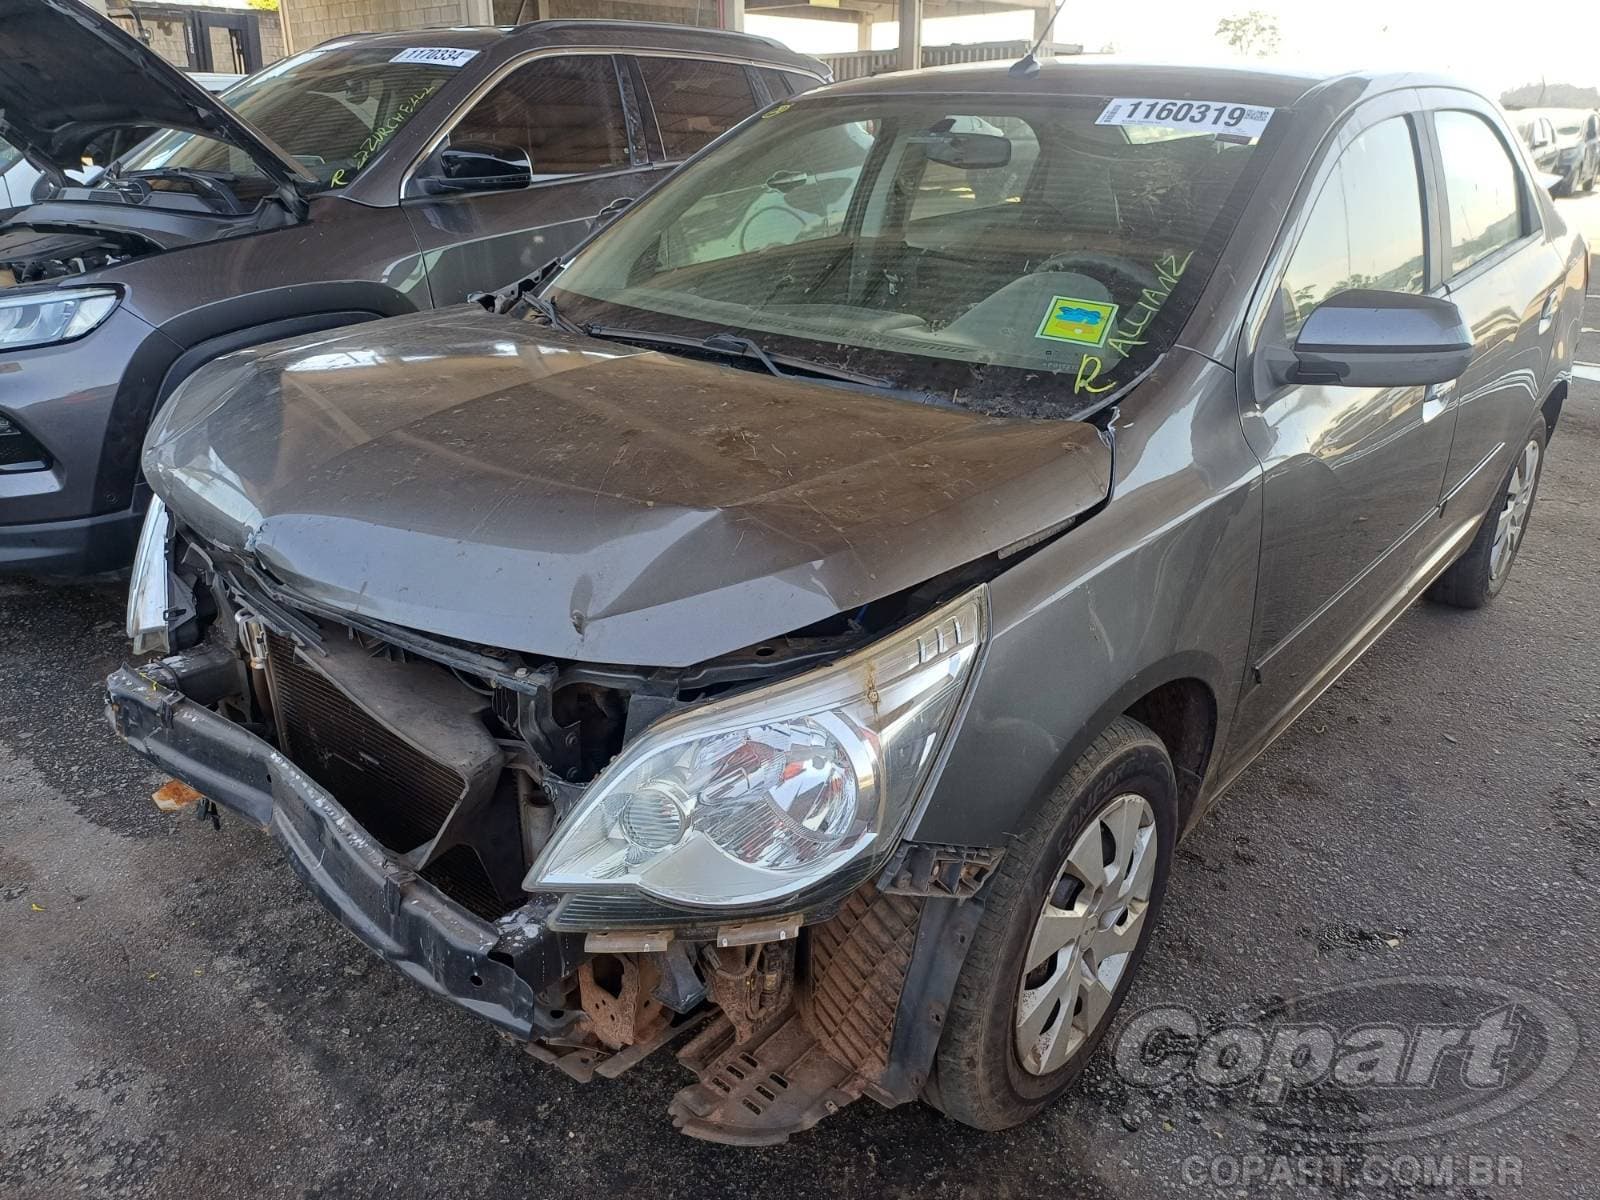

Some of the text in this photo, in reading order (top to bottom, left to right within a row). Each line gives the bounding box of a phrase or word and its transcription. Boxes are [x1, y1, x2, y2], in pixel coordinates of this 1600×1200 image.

[407, 49, 464, 61] 1170334
[1127, 101, 1246, 127] 1160319
[330, 169, 348, 188] R
[1075, 250, 1194, 394] R ALLIANZ
